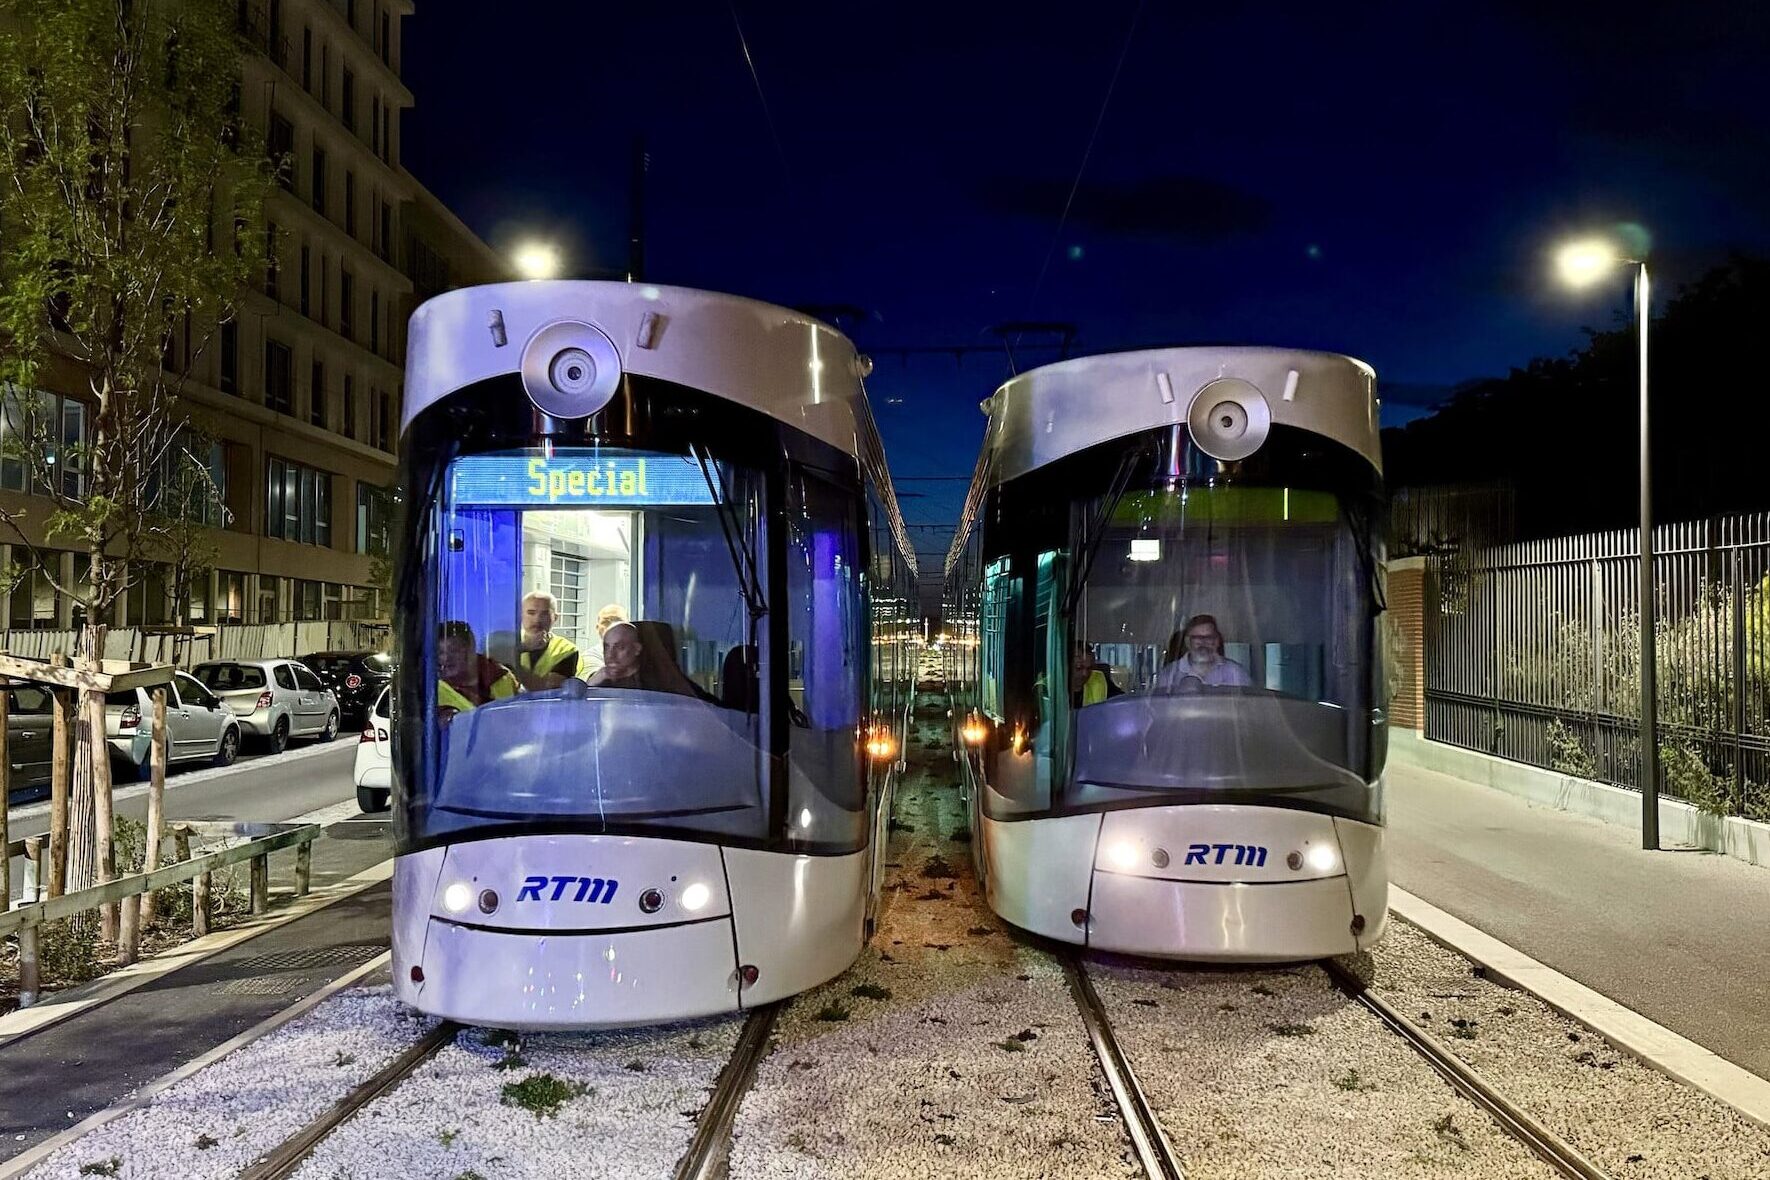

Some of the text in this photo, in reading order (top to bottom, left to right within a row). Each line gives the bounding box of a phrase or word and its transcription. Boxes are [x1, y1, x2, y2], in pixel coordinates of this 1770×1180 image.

[528, 458, 649, 503] Special
[1184, 844, 1267, 867] RTM
[516, 876, 618, 904] RTM
